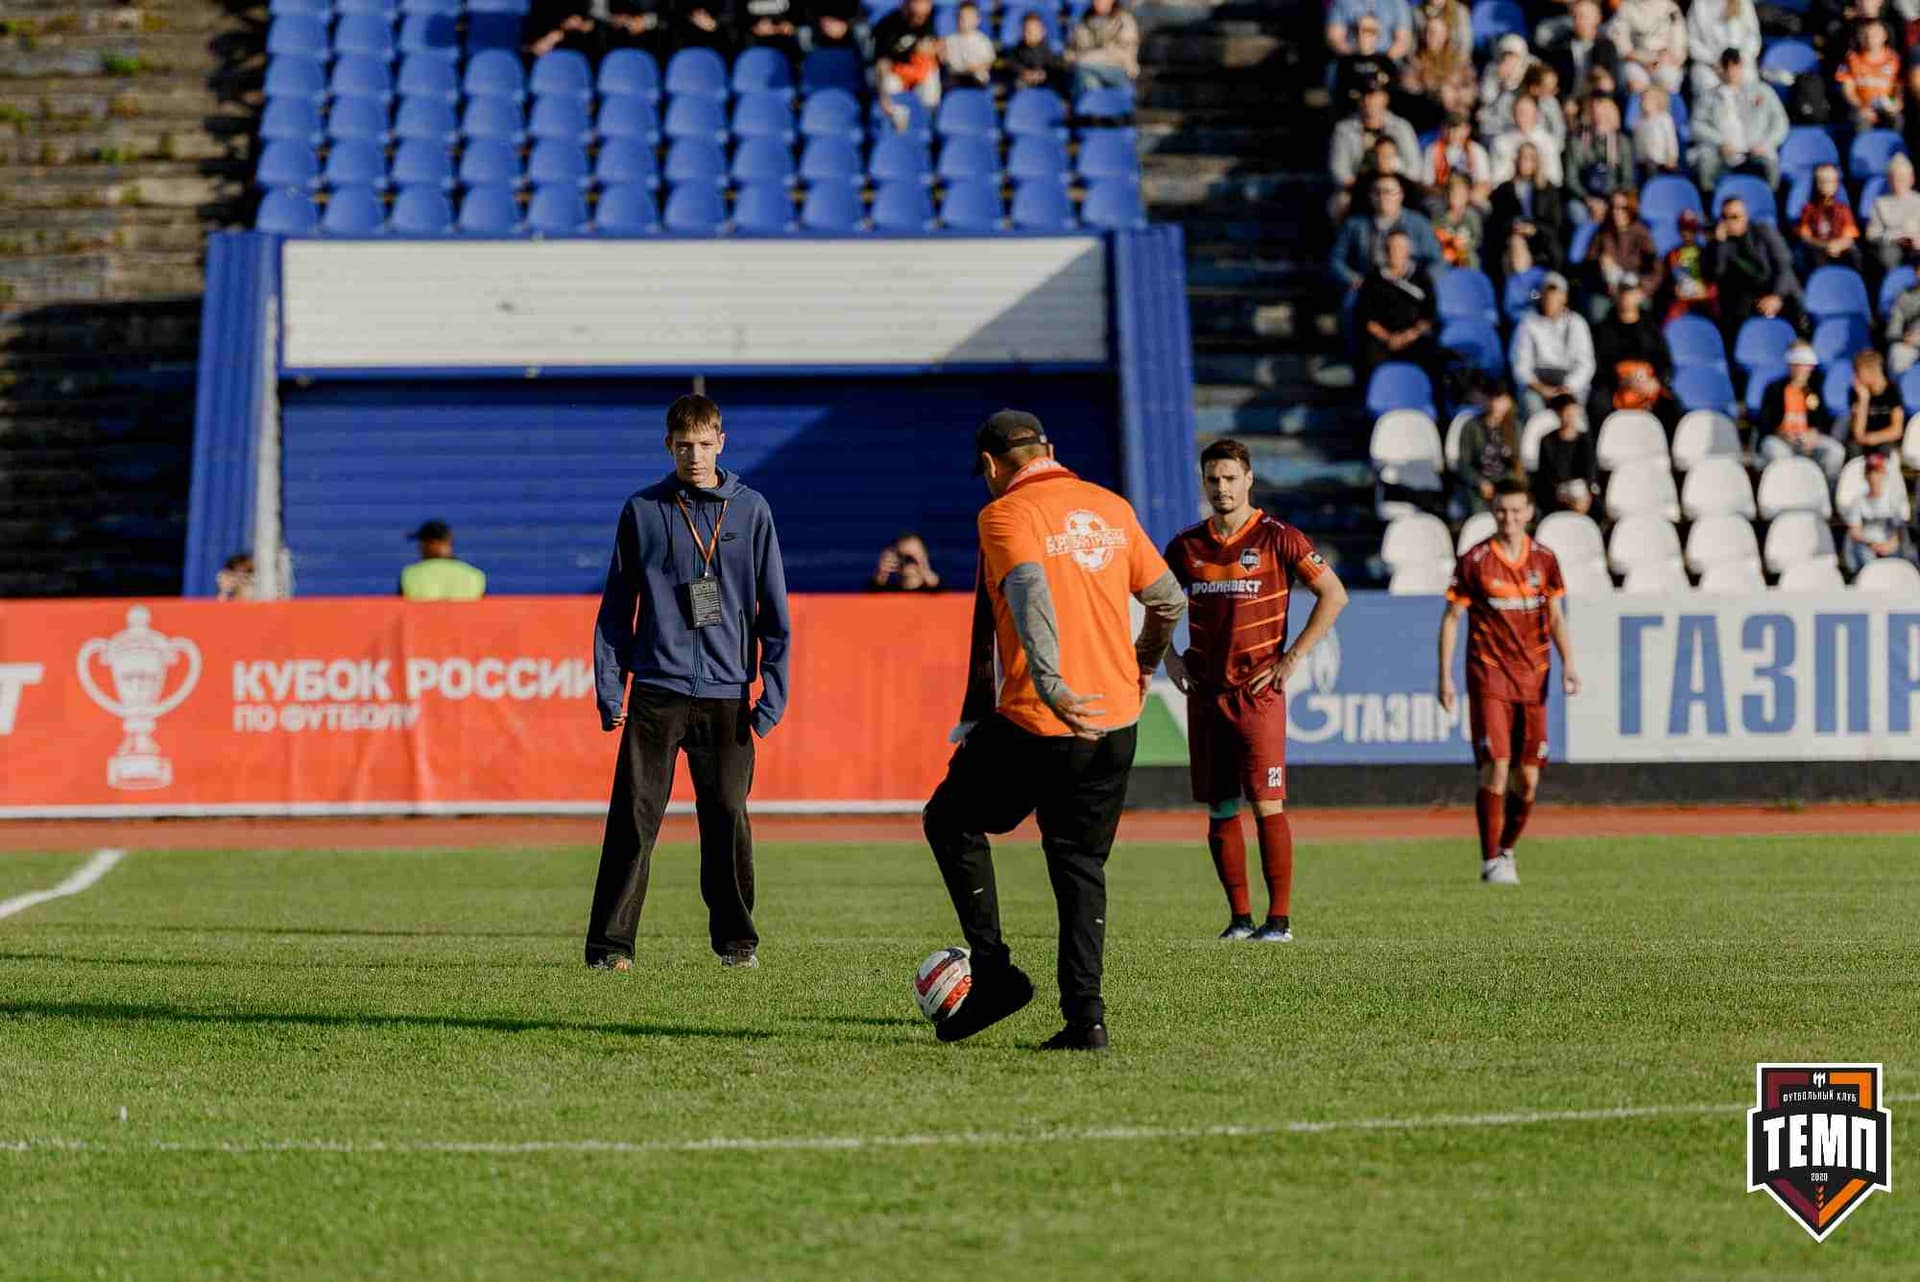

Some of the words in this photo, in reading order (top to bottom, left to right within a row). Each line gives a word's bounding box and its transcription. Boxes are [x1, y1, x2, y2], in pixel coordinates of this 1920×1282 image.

[233, 659, 392, 701] КУБОК
[233, 704, 277, 733] ПО
[1343, 693, 1472, 742] ГАЗПР
